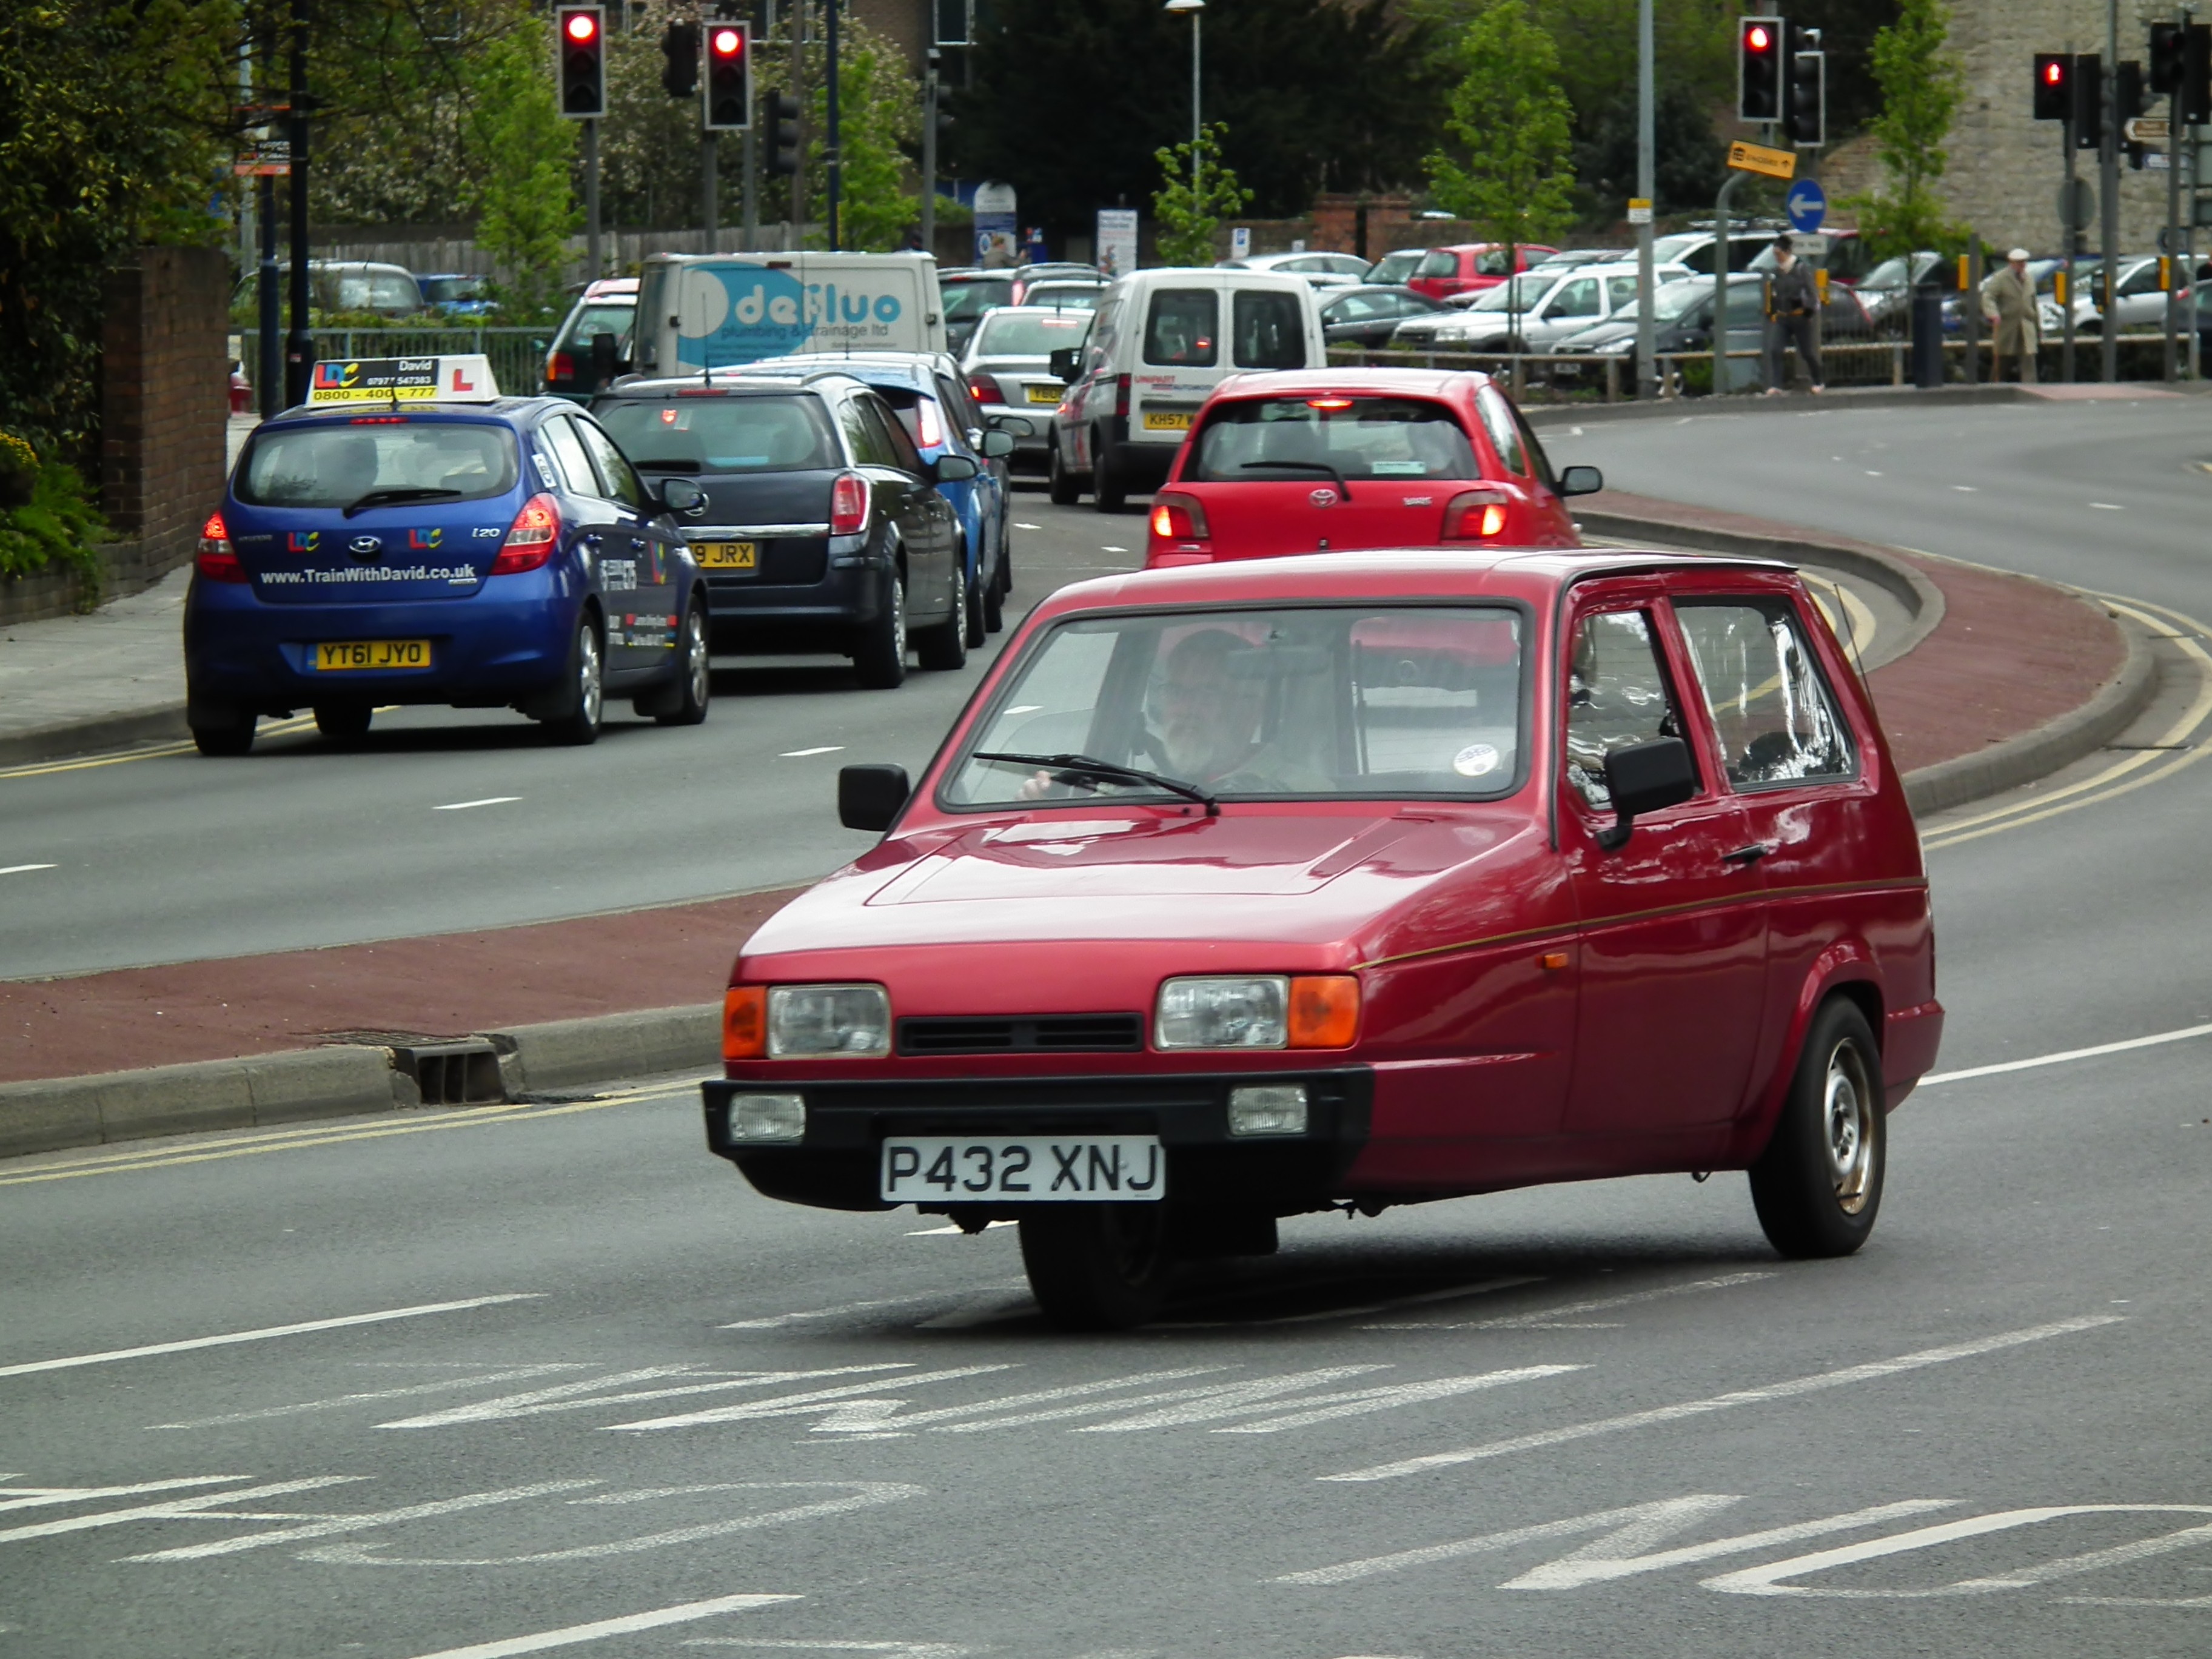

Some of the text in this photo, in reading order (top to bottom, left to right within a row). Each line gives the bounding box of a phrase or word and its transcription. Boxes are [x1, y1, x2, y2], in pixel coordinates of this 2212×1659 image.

[736, 283, 901, 324] defluo
[721, 324, 787, 340] plumbing
[802, 324, 867, 338] drainage
[871, 324, 888, 336] ltd
[315, 362, 360, 389] LDC
[399, 361, 432, 372] David
[452, 369, 474, 392] L
[314, 390, 350, 400] 0800
[366, 389, 394, 398] 400
[409, 387, 437, 397] 777
[1150, 414, 1183, 425] KH57
[287, 531, 320, 553] LDC
[409, 528, 443, 549] LDC
[472, 528, 501, 538] i20
[713, 545, 751, 563] JRX
[261, 563, 475, 585] www.TrainWithDavid.co.uk
[324, 642, 421, 665] YT61 JYO
[888, 1145, 1158, 1192] P432 XNJ
